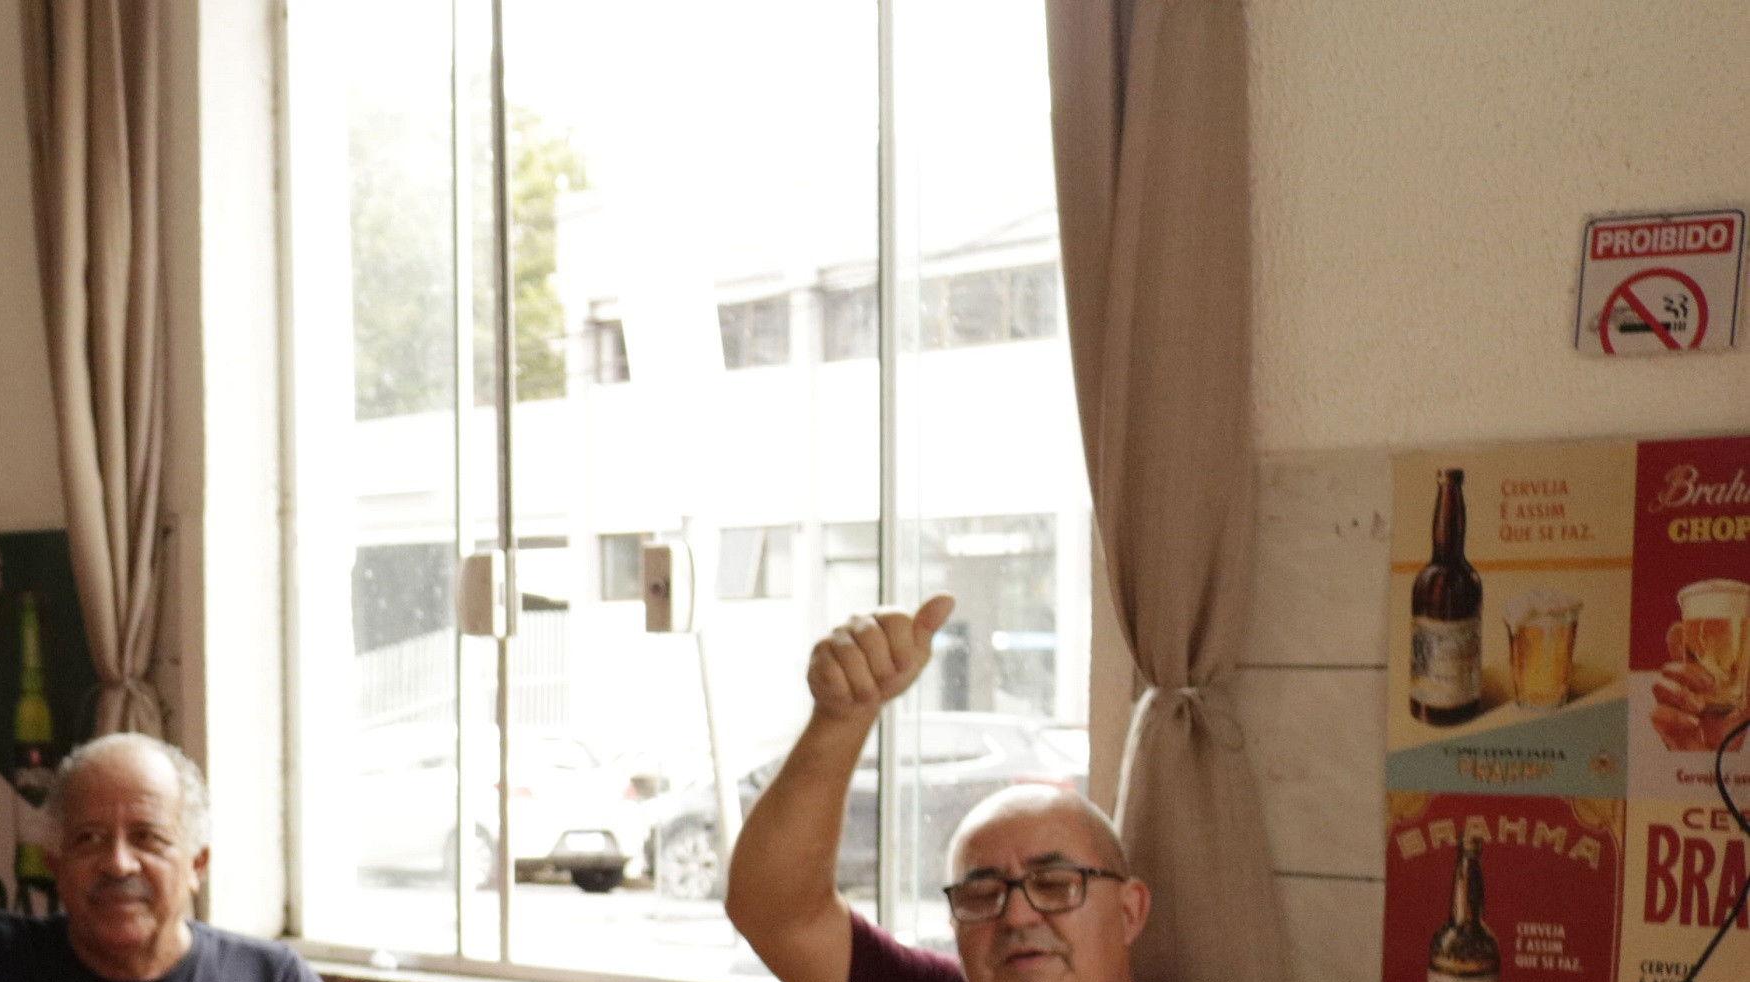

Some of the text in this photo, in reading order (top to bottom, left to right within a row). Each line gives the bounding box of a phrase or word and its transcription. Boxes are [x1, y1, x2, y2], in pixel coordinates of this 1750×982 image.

[1595, 222, 1729, 256] PROIBIDO
[1498, 478, 1569, 497] CERVEJA
[1514, 502, 1565, 519] ASSIM
[1497, 521, 1531, 541] QUE
[1538, 524, 1554, 541] SE
[1396, 814, 1601, 871] BRAHMA
[1516, 921, 1565, 938] CERVEJA
[1526, 938, 1563, 954] ASSIM
[1515, 954, 1537, 969] QUE
[1640, 960, 1699, 977] CERVEJ
